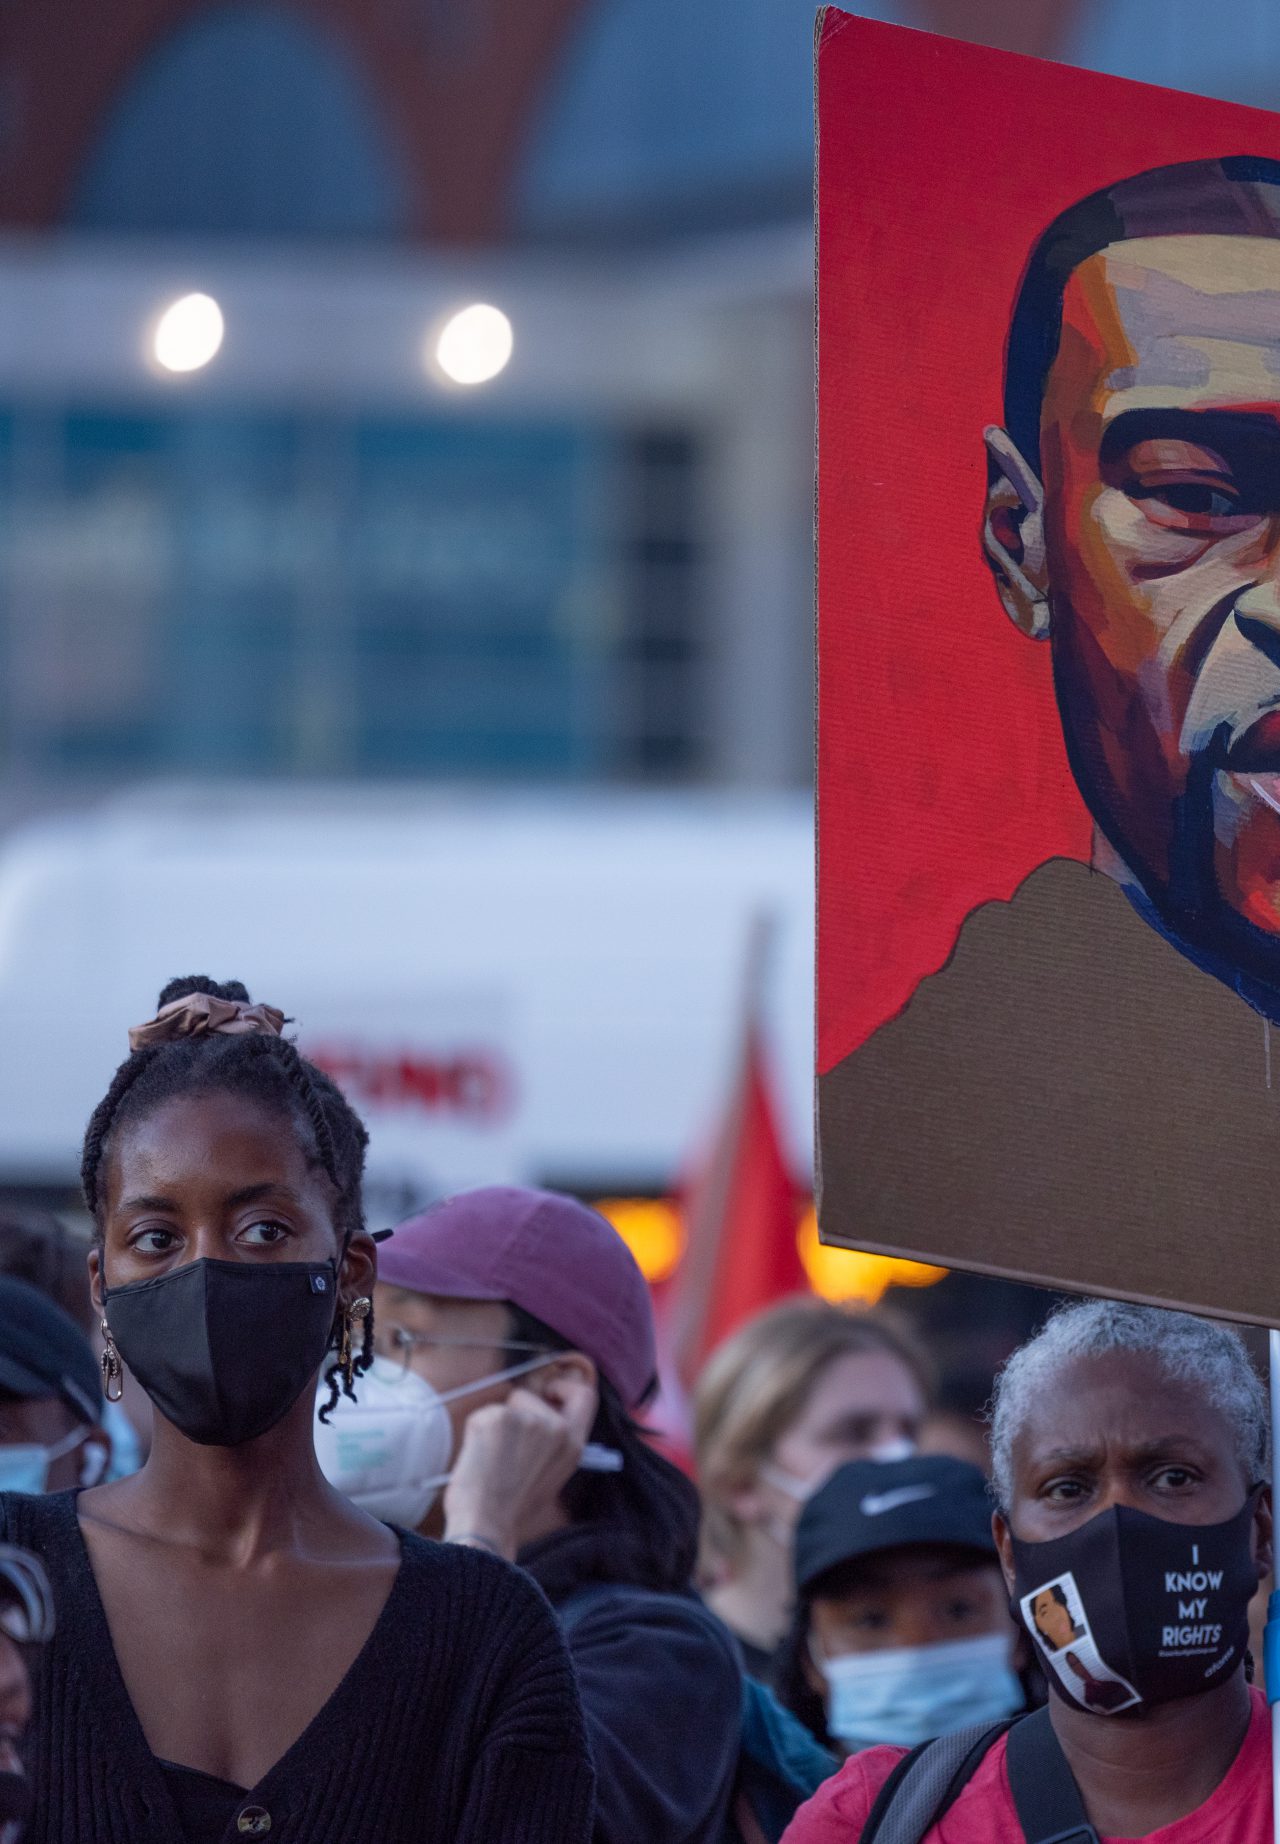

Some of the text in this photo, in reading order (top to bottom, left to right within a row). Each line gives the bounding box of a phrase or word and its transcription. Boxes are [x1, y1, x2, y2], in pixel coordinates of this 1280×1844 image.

[1191, 1544, 1199, 1566] I
[1164, 1570, 1224, 1592] KNOW
[1178, 1597, 1208, 1619] MY
[1162, 1623, 1222, 1647] RIGHTS
